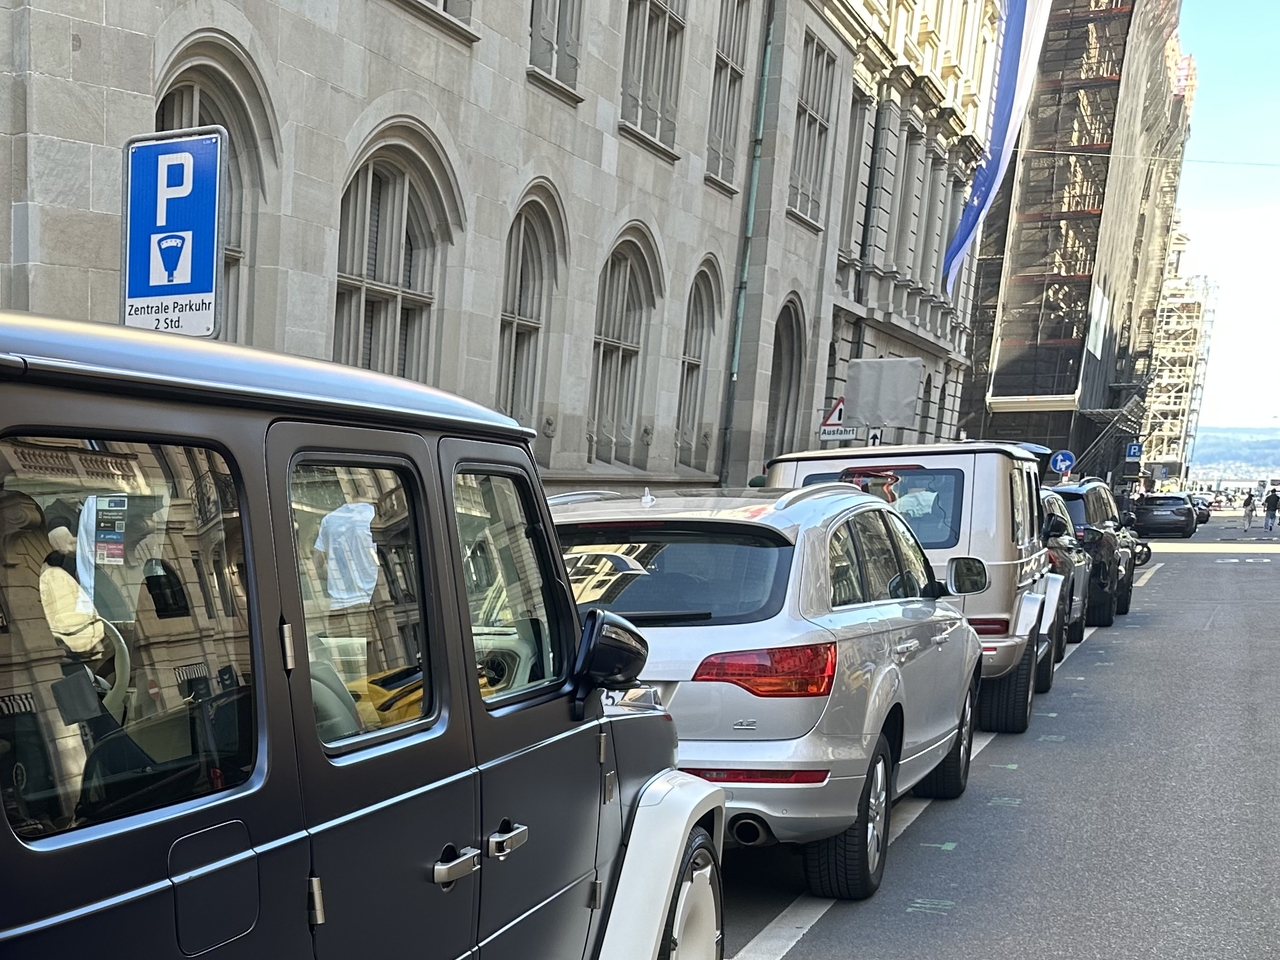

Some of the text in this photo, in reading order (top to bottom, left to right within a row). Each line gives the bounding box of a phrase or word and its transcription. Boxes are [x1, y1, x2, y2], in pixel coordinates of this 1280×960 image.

[156, 152, 193, 226] P
[128, 299, 212, 316] Zentrale Parkuhr
[154, 316, 183, 329] 2 Std.
[822, 428, 855, 436] Ausfahrt
[1131, 446, 1139, 455] P
